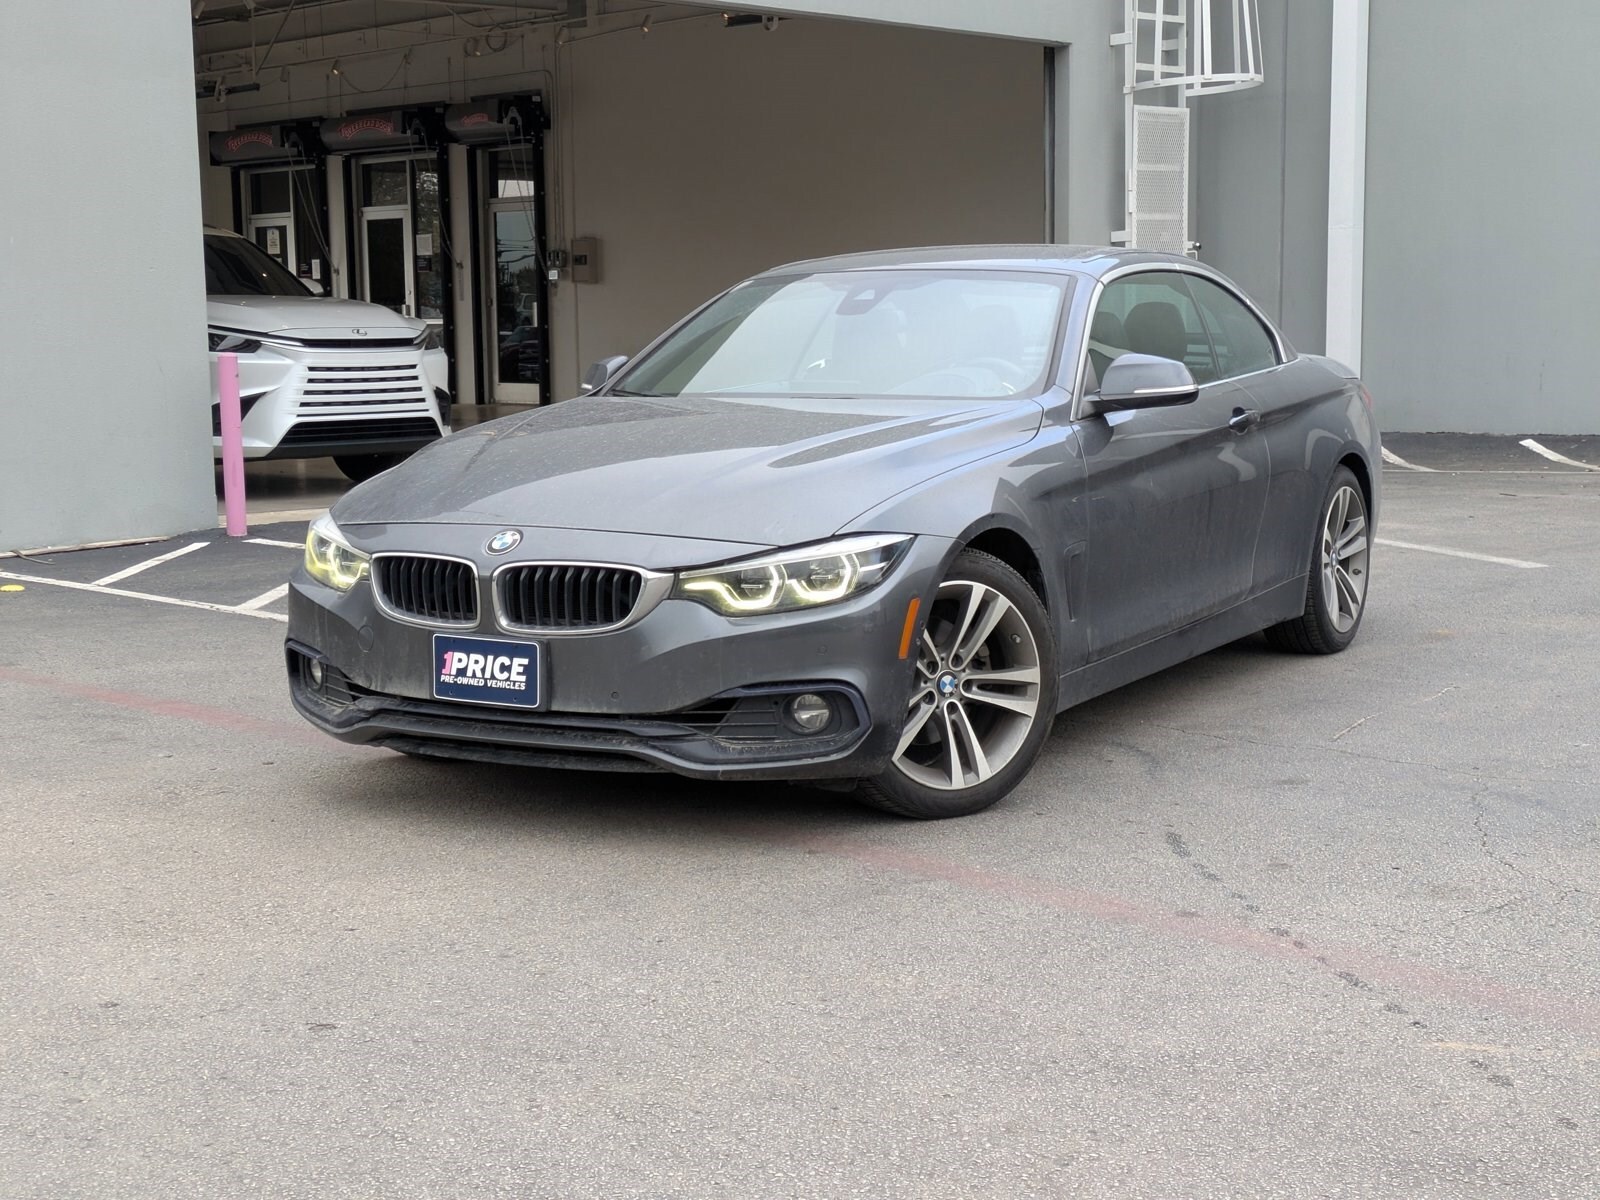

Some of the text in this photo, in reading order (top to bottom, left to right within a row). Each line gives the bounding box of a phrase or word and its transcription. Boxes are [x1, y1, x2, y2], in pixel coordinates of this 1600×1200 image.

[442, 651, 529, 682] 1PRICE
[440, 675, 526, 690] PRE-OWNED VEHICLES
